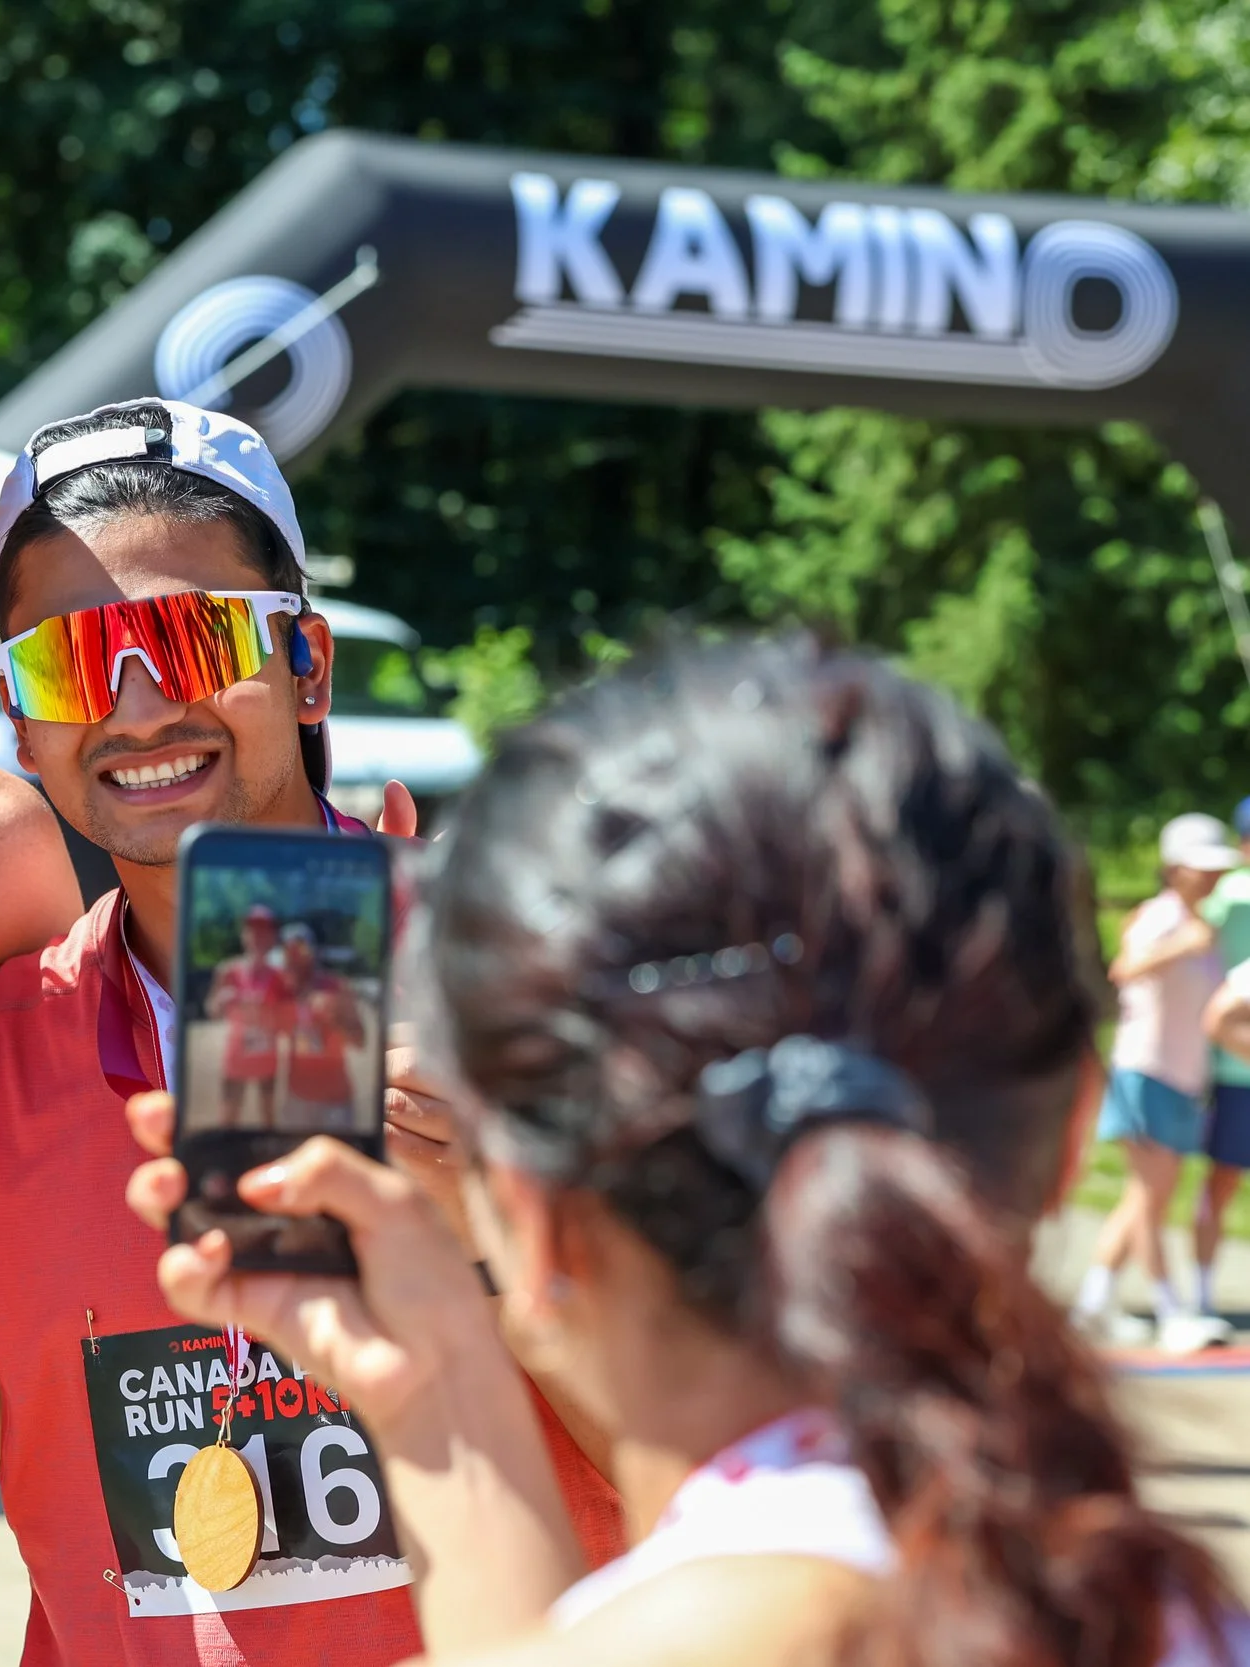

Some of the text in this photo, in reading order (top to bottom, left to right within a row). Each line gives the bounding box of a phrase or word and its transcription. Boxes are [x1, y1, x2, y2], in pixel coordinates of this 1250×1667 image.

[509, 172, 1179, 391] KAMINO
[182, 1336, 225, 1352] KAMIN
[119, 1352, 283, 1402] CANADA
[124, 1377, 350, 1437] RUN 5+10K
